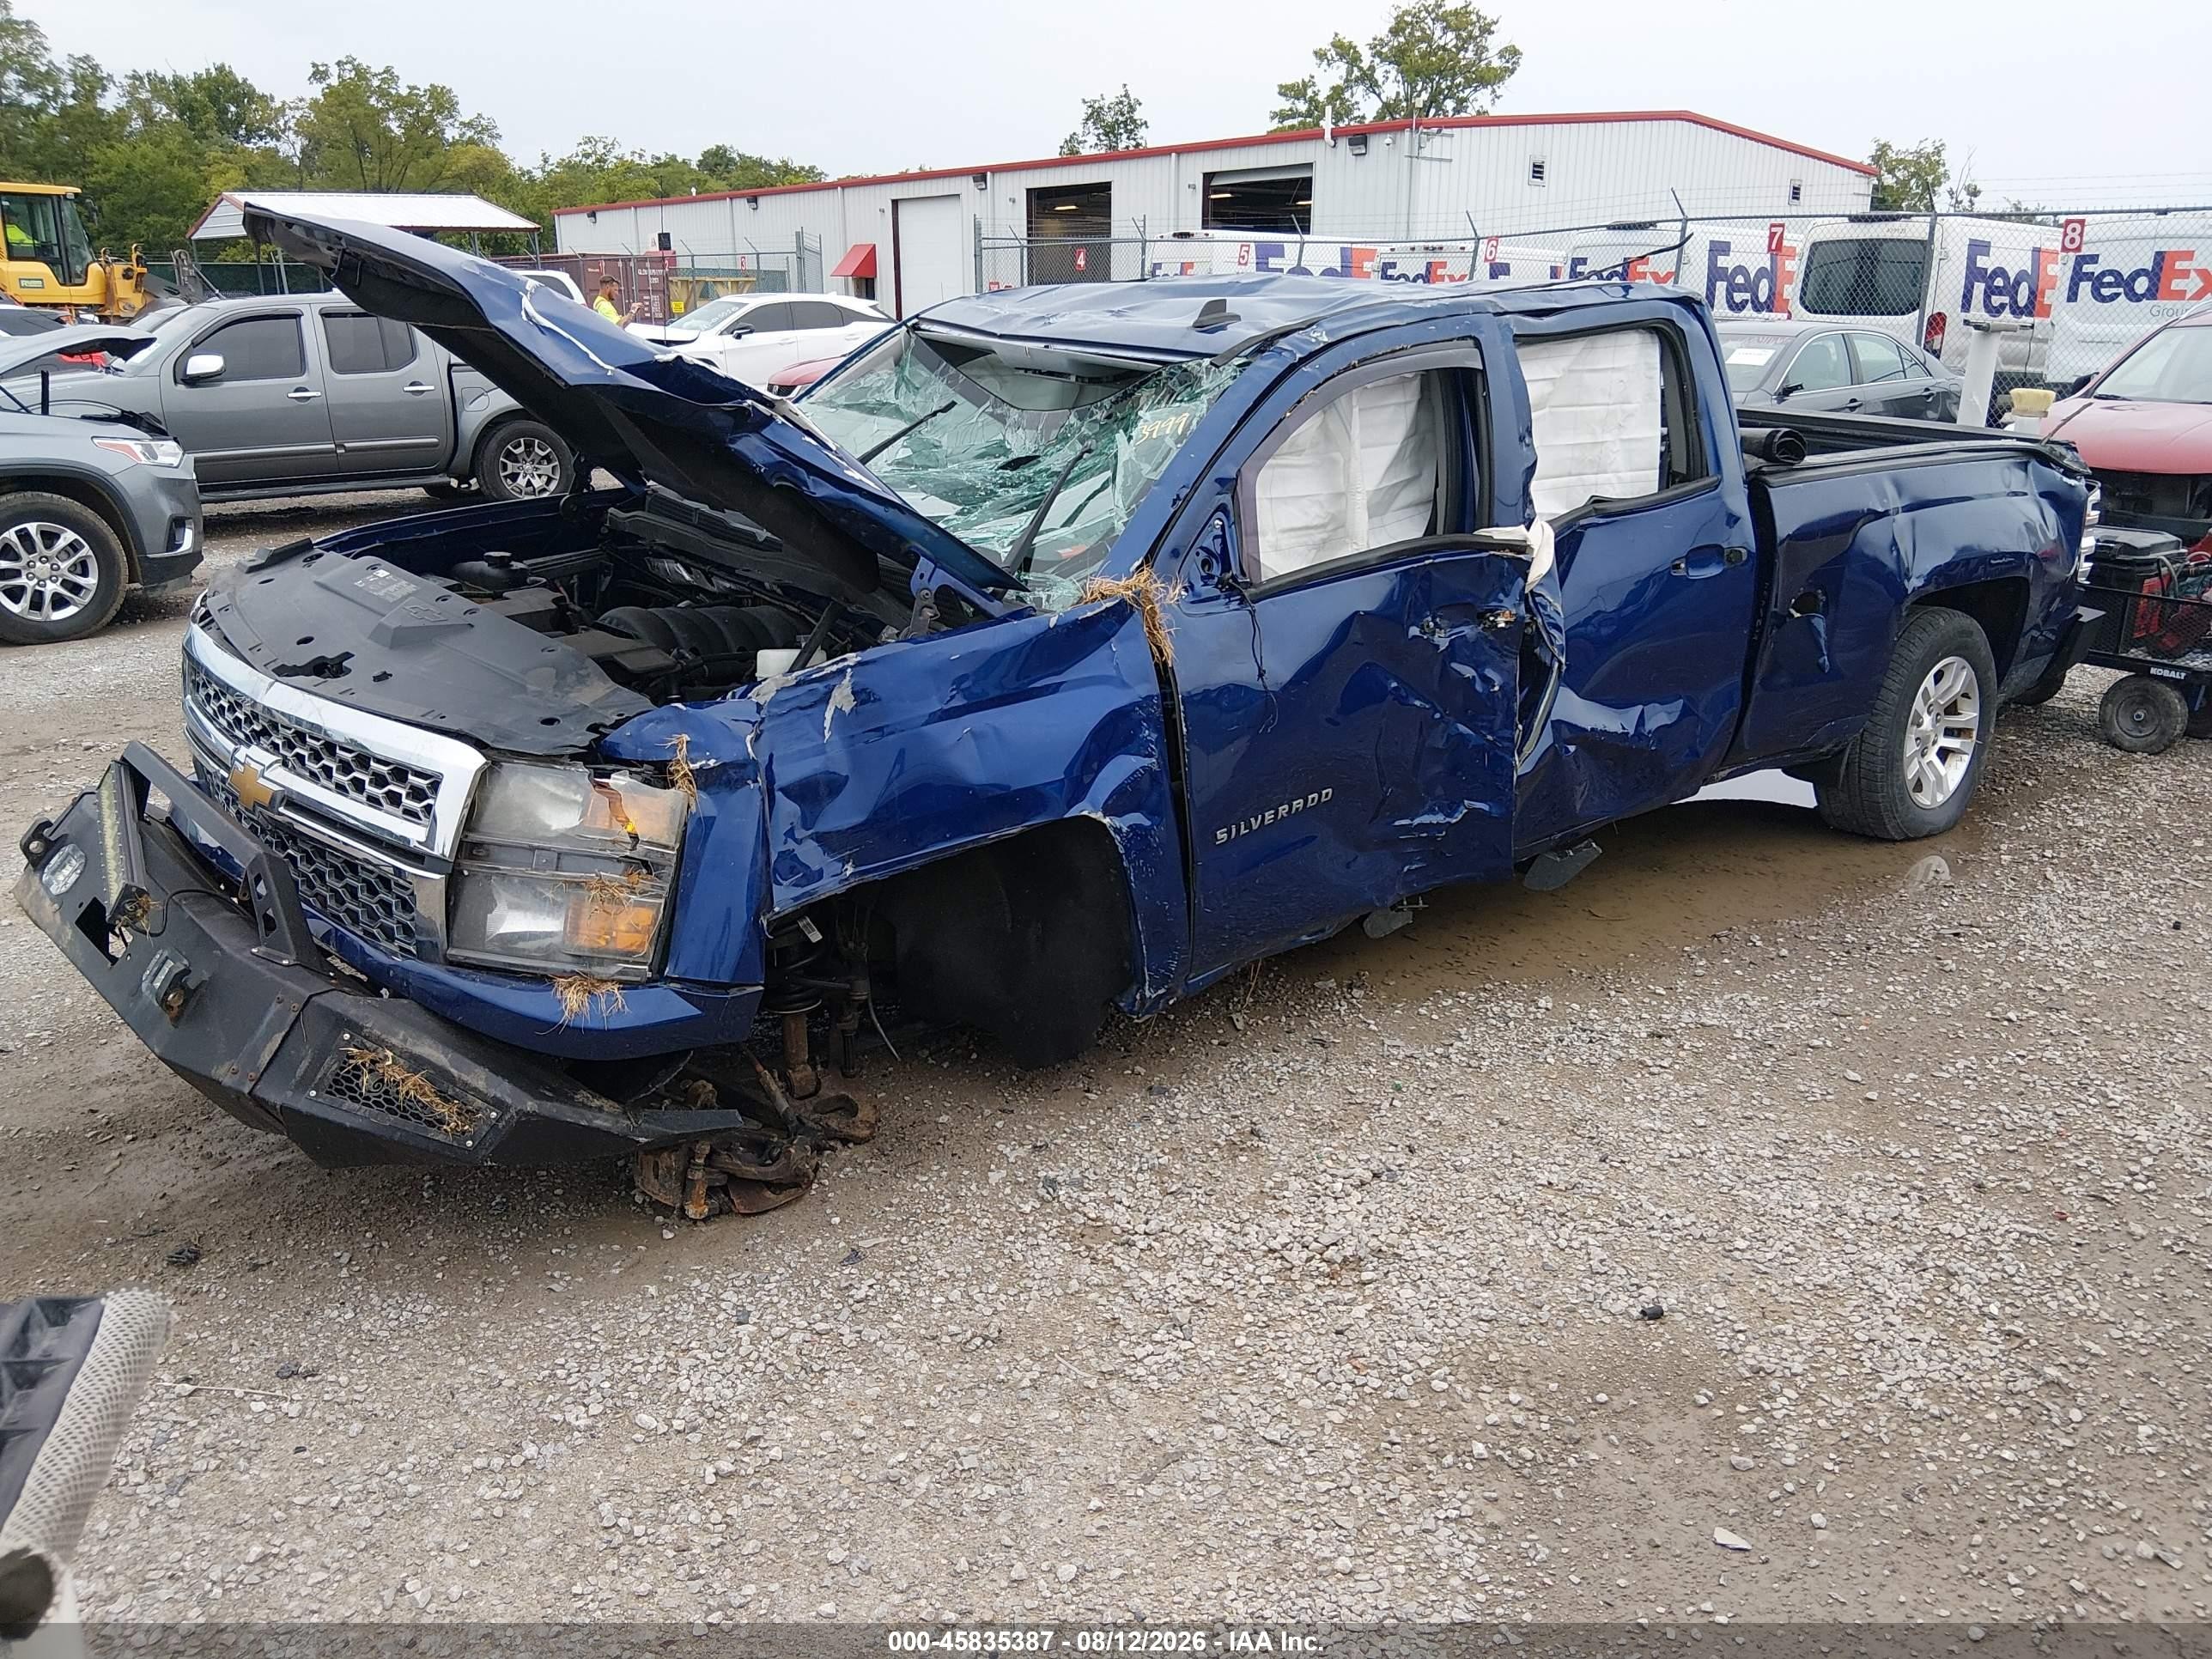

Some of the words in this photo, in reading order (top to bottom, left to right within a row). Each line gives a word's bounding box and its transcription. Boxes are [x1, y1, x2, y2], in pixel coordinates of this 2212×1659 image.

[1771, 228, 1784, 250] 7
[2063, 222, 2081, 249] 8
[1077, 252, 1085, 268] 4
[1239, 246, 1249, 264] 5
[1486, 240, 1497, 261] 6
[741, 258, 746, 270] 3
[2149, 666, 2187, 680] KOBALT
[1215, 787, 1333, 845] SILVERADO
